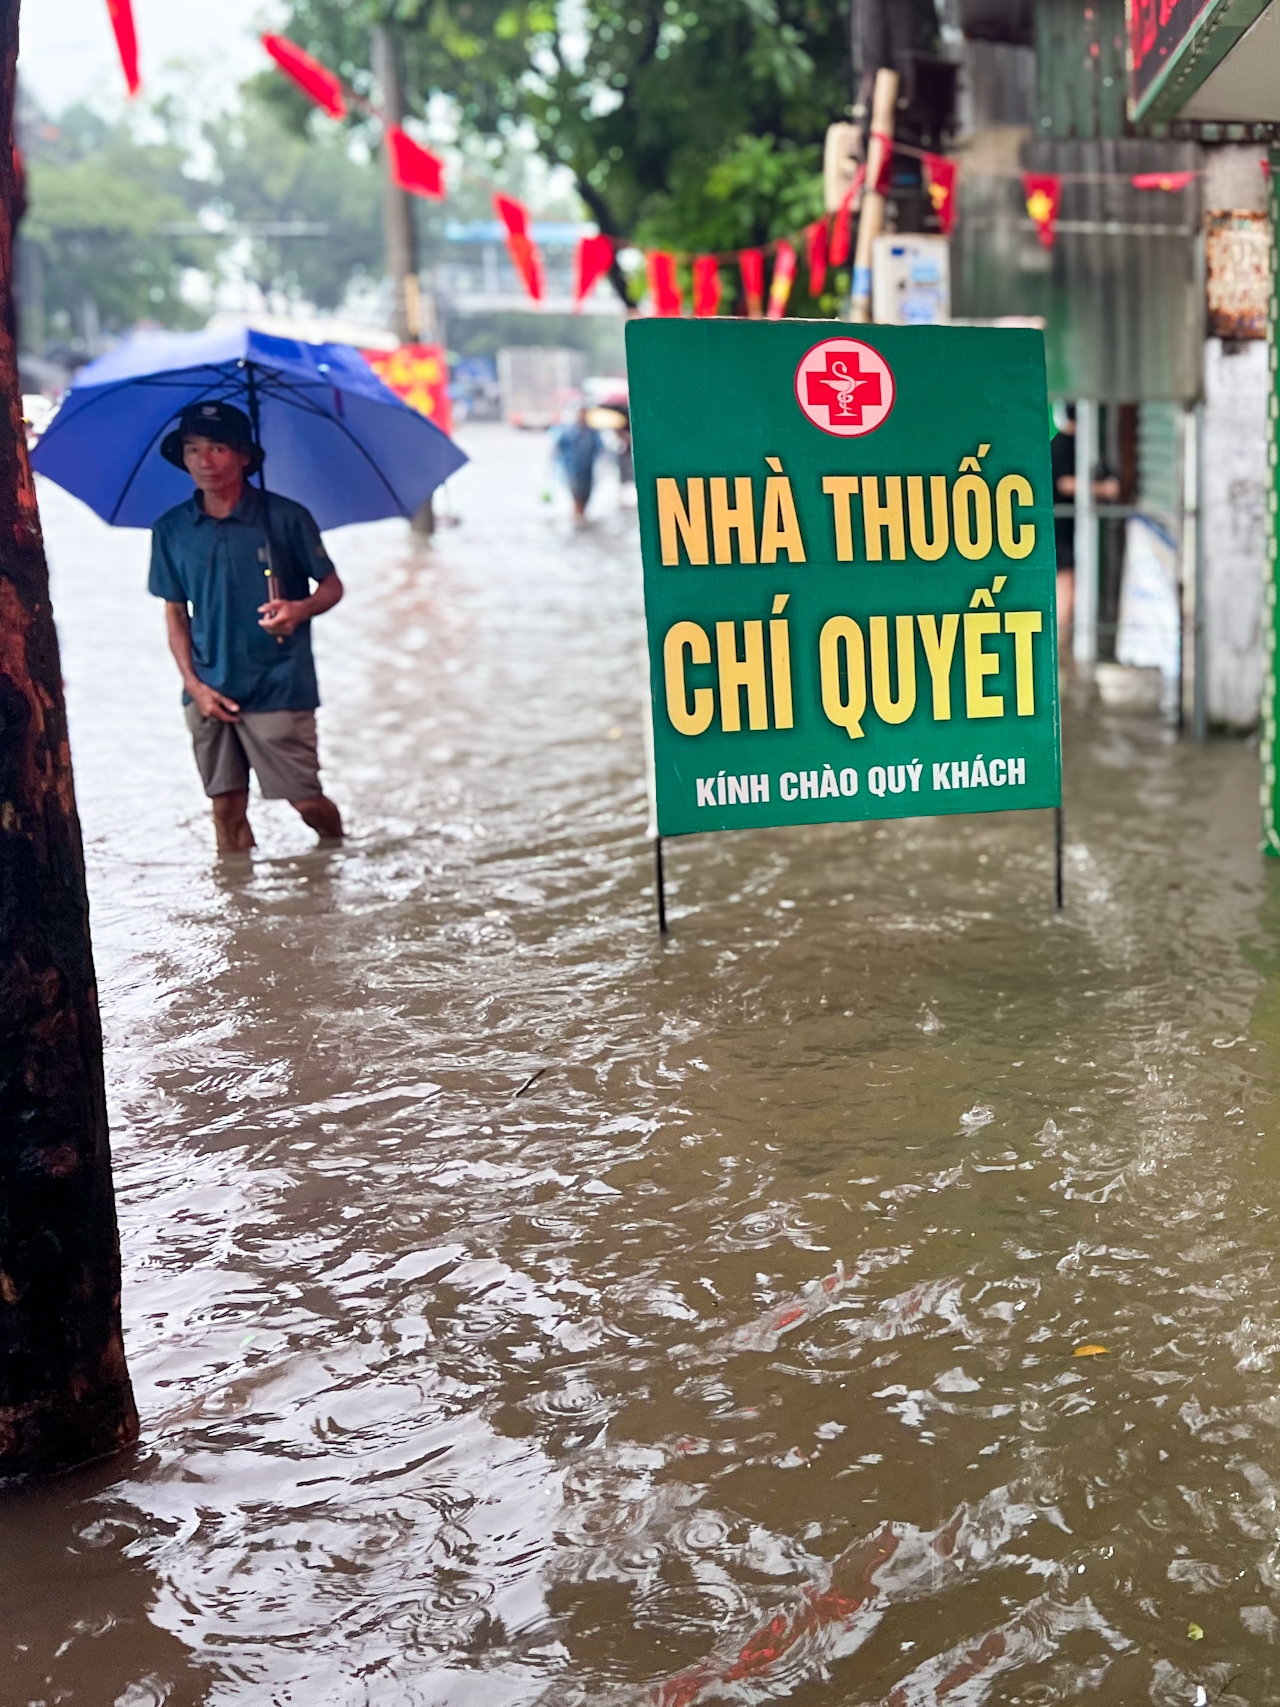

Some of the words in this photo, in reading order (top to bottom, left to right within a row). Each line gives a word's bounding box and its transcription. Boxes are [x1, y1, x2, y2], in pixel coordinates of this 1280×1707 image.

[656, 456, 807, 566] NHÀ
[822, 443, 1036, 562] THUỐC
[663, 593, 794, 737] CHÍ
[819, 576, 1043, 740] QUYẾT
[696, 769, 770, 807] KÍNH
[779, 763, 859, 800] CHÀO
[867, 757, 924, 796] QUÝ
[932, 754, 1026, 791] KHÁCH
